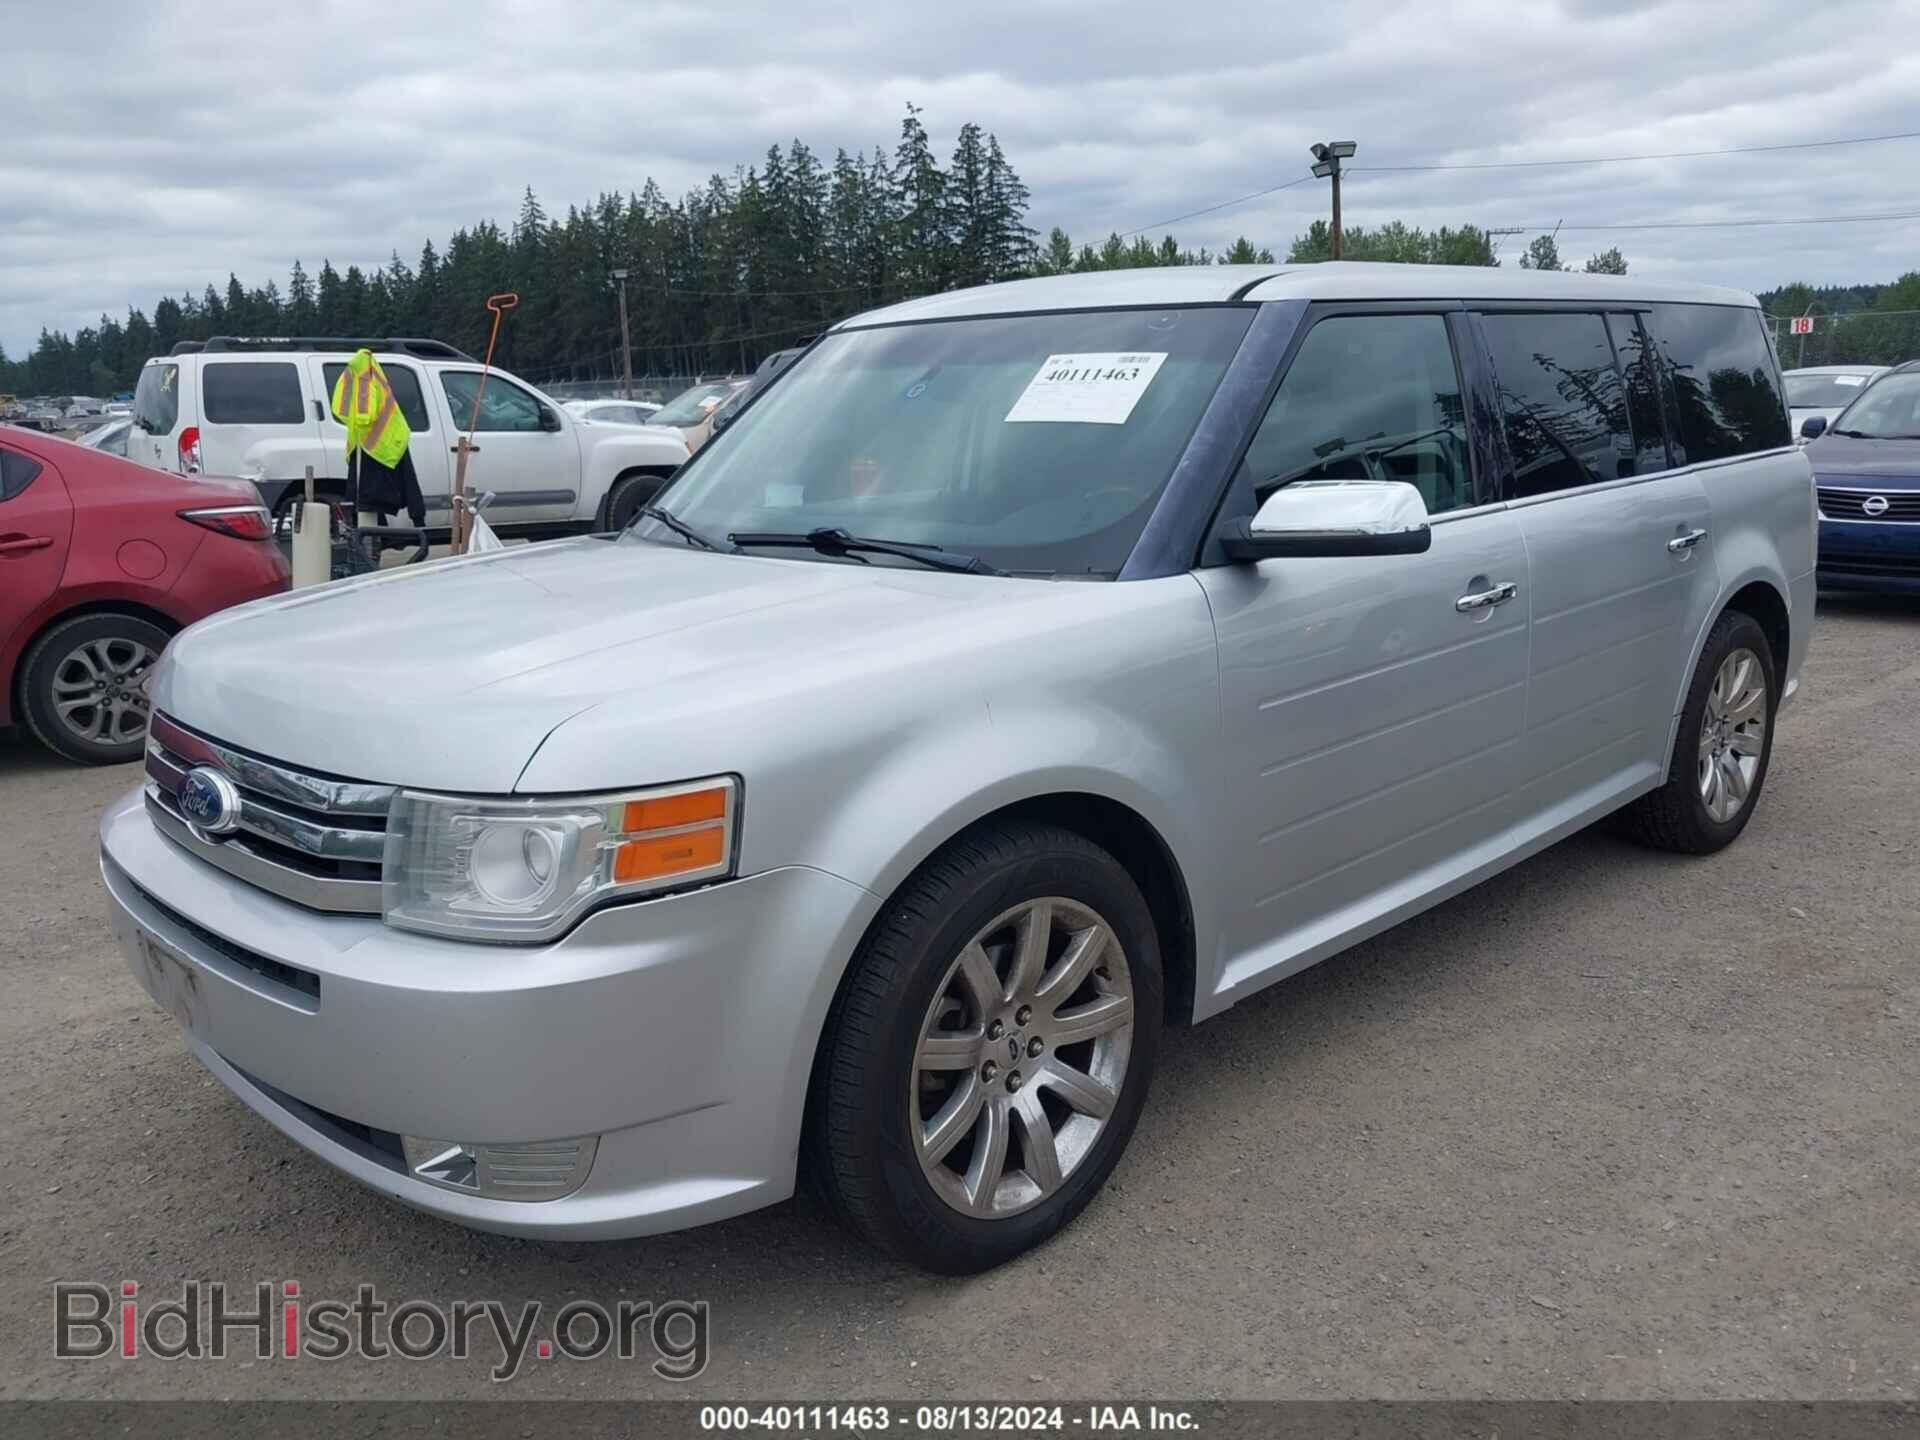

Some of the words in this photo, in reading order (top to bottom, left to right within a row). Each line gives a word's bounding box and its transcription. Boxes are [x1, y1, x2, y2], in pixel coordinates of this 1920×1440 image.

[1794, 318, 1810, 333] 18
[1044, 367, 1140, 382] 40111463
[181, 778, 212, 817] Ford
